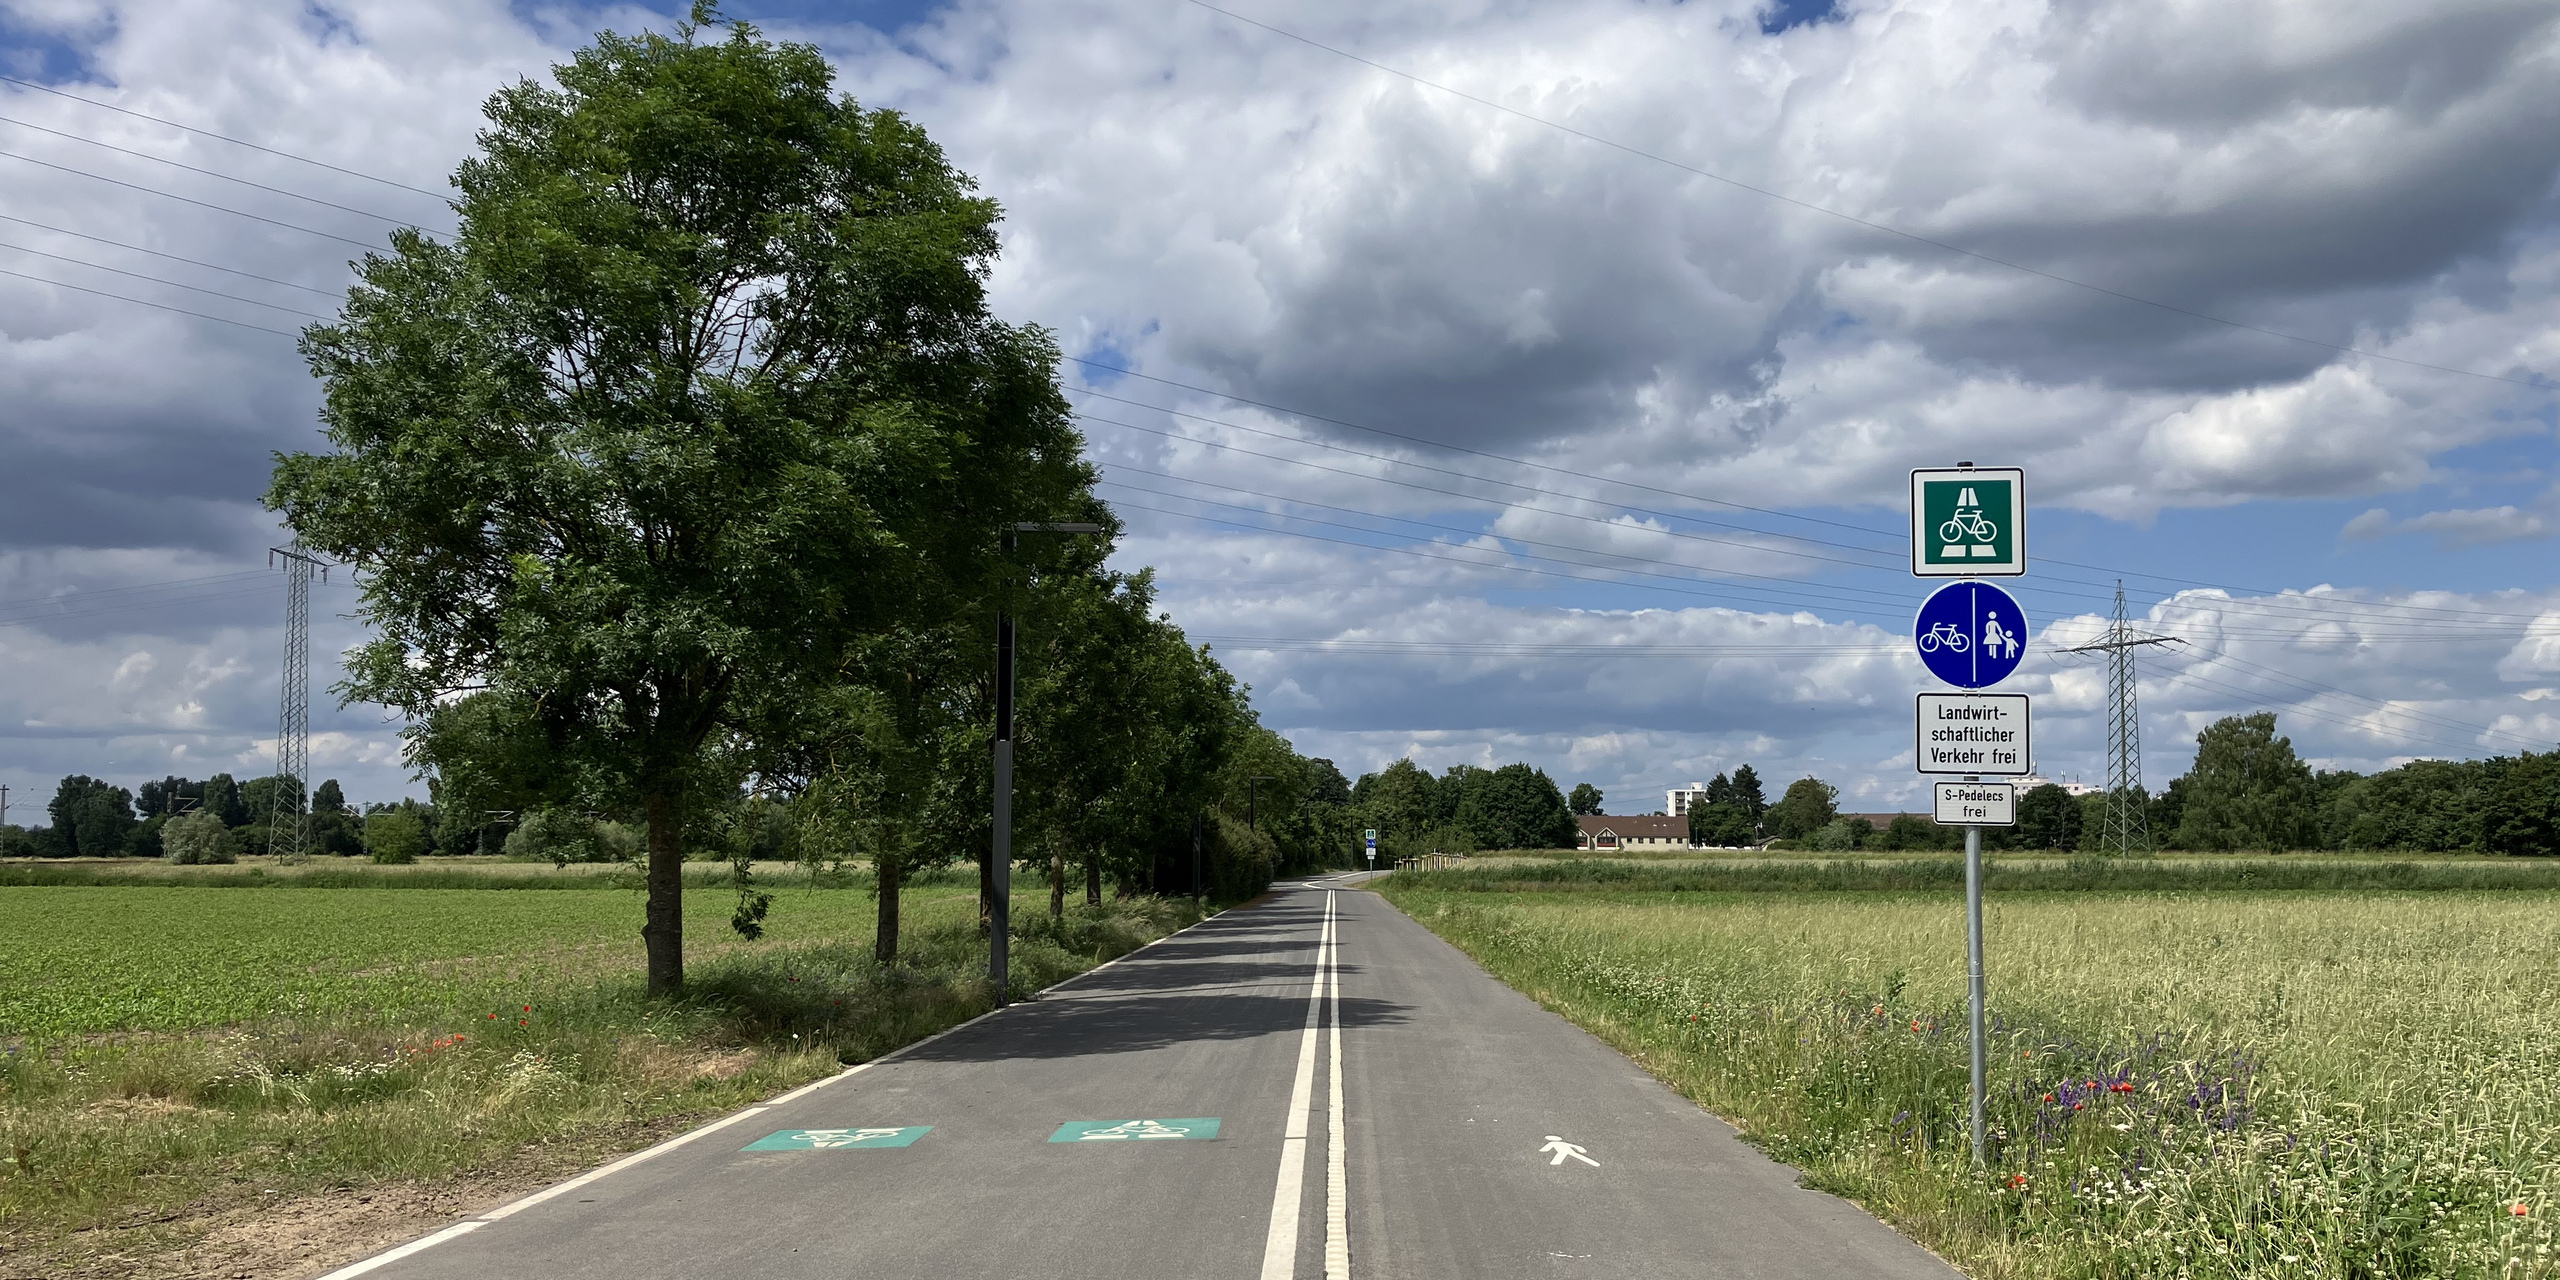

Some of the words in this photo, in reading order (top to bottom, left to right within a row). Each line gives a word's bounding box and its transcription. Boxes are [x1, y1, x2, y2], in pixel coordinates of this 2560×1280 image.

[1938, 704, 2008, 720] Landwirt-
[1931, 726, 2015, 743] schaftlicher
[1931, 747, 1985, 764] Verkehr
[1992, 748, 2016, 765] frei
[1945, 789, 2004, 802] S-Pedelecs
[1963, 805, 1987, 818] frei
